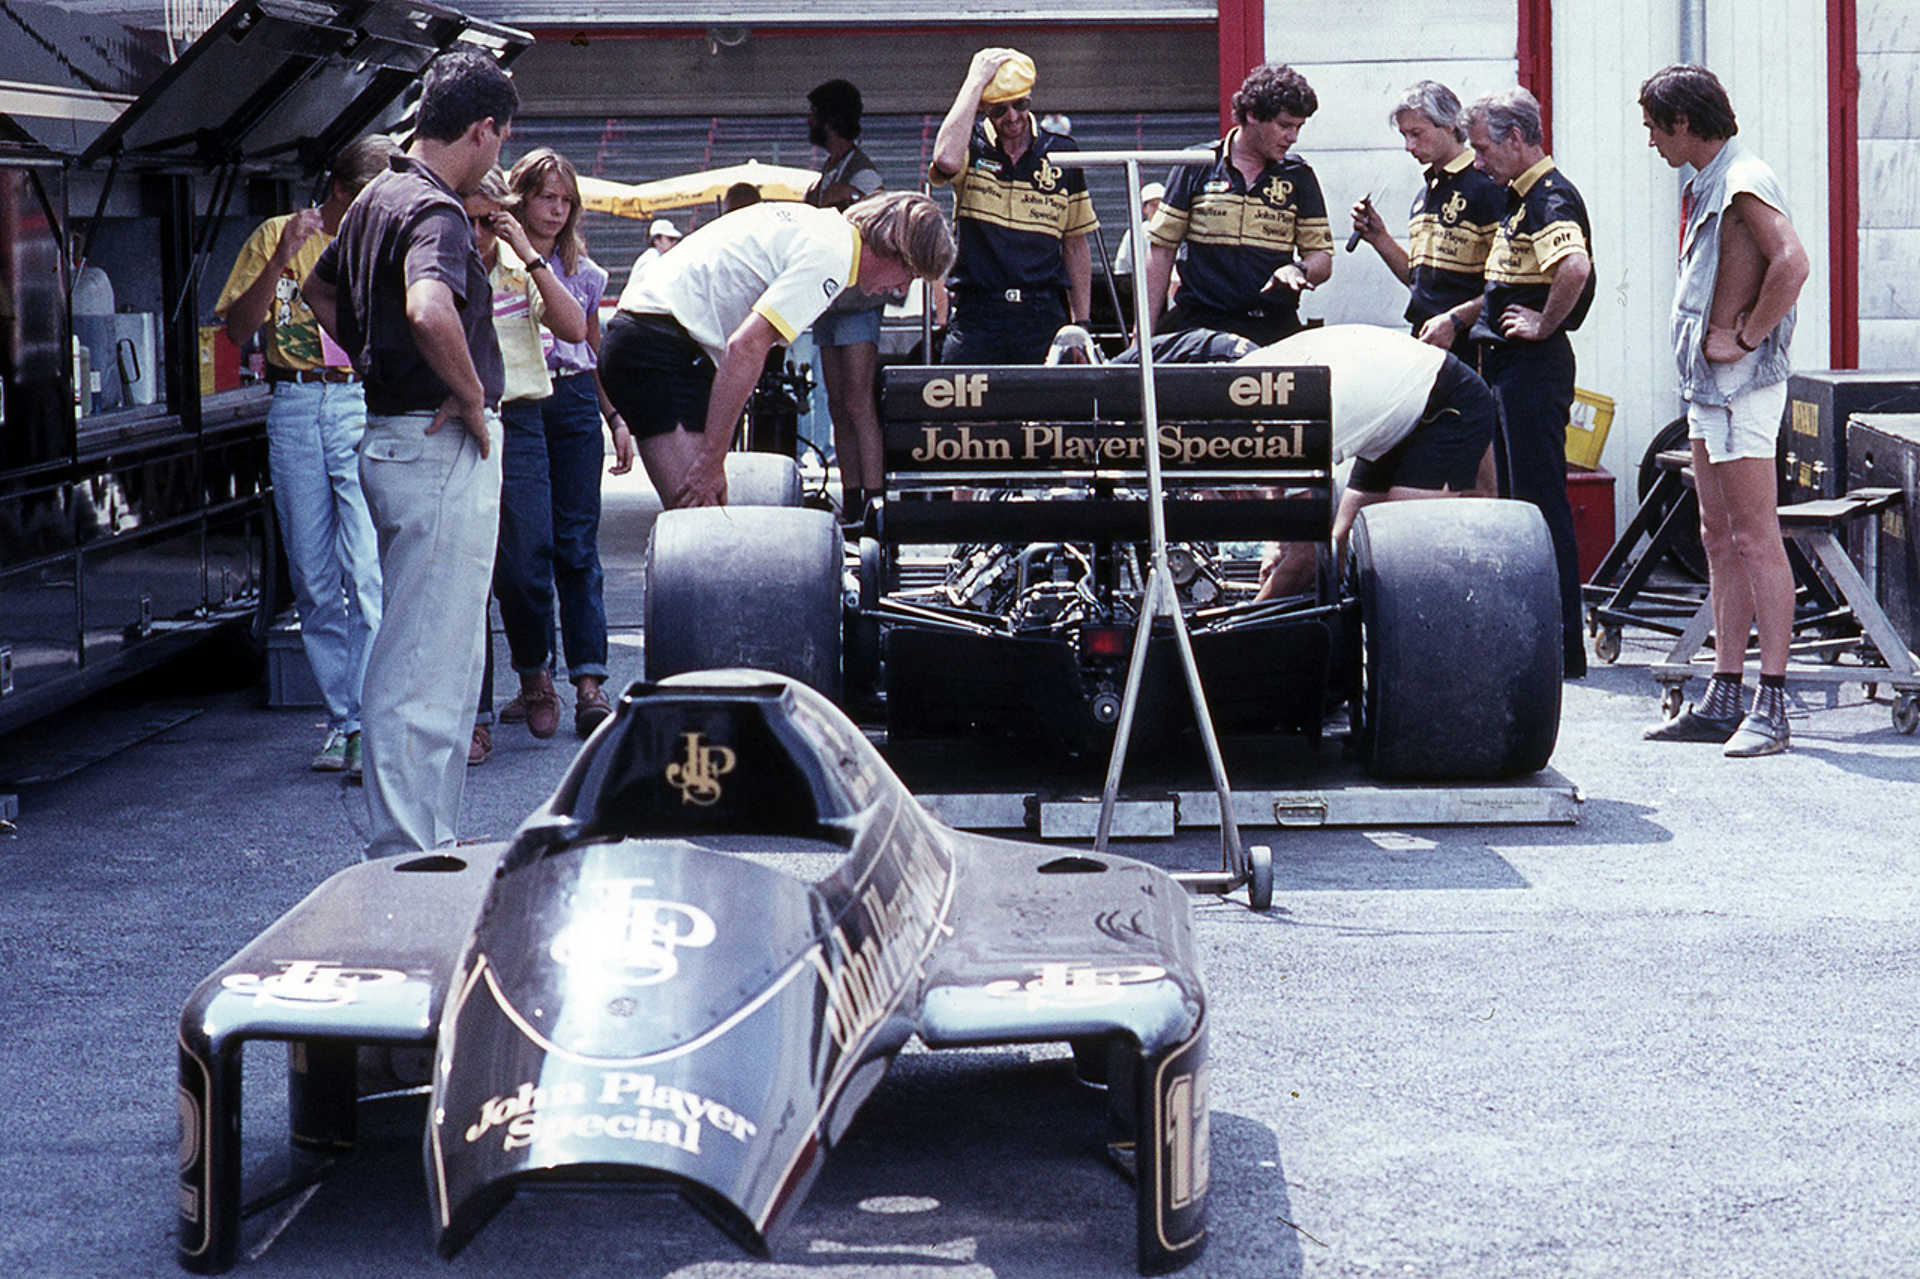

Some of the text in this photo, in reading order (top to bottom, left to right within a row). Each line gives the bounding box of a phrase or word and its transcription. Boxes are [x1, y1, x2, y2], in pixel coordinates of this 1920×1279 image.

[922, 373, 988, 408] elf
[1229, 371, 1295, 406] elf
[911, 424, 1306, 464] John Player Special
[665, 732, 736, 806] JPS
[465, 1071, 757, 1144] John Player
[503, 1108, 701, 1155] Special
